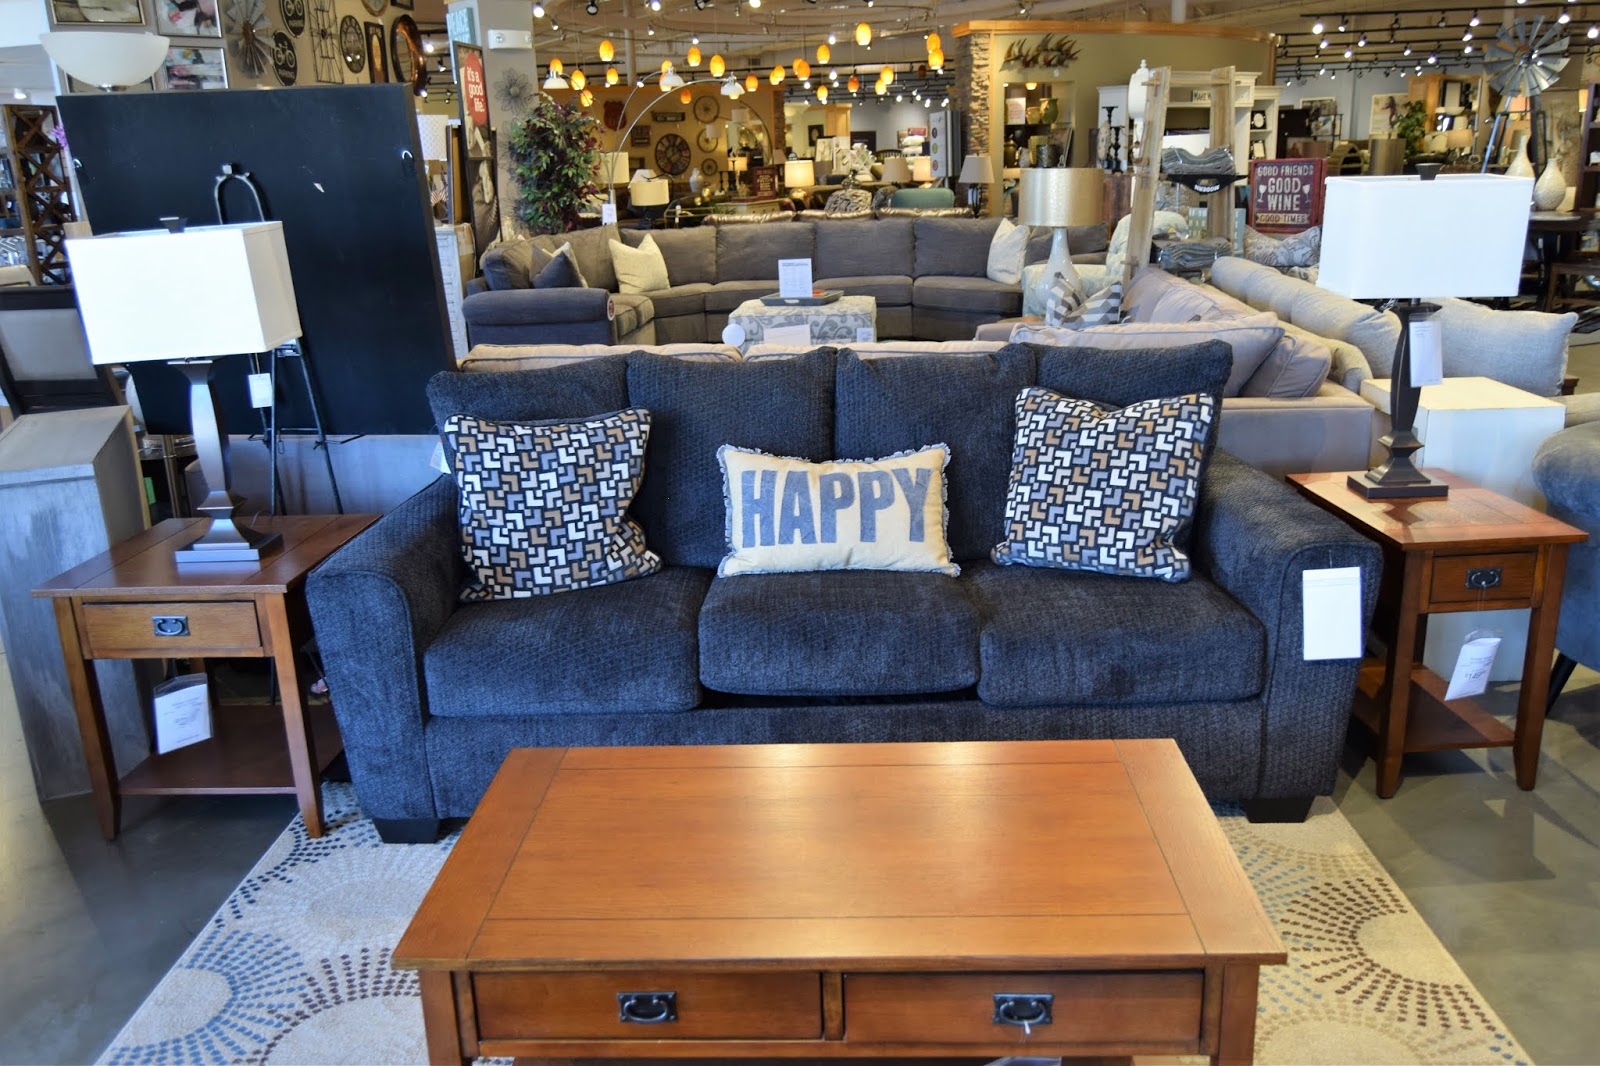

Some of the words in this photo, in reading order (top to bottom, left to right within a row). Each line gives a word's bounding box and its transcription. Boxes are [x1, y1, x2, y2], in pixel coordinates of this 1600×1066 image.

[469, 82, 484, 98] good
[1257, 165, 1278, 177] GOOD
[1280, 165, 1314, 176] FRIENDS
[1267, 177, 1301, 193] GOOD
[1267, 194, 1301, 211] WINE
[1259, 214, 1281, 223] GOOD
[1283, 214, 1306, 224] TIMES
[741, 468, 934, 548] HAPPY
